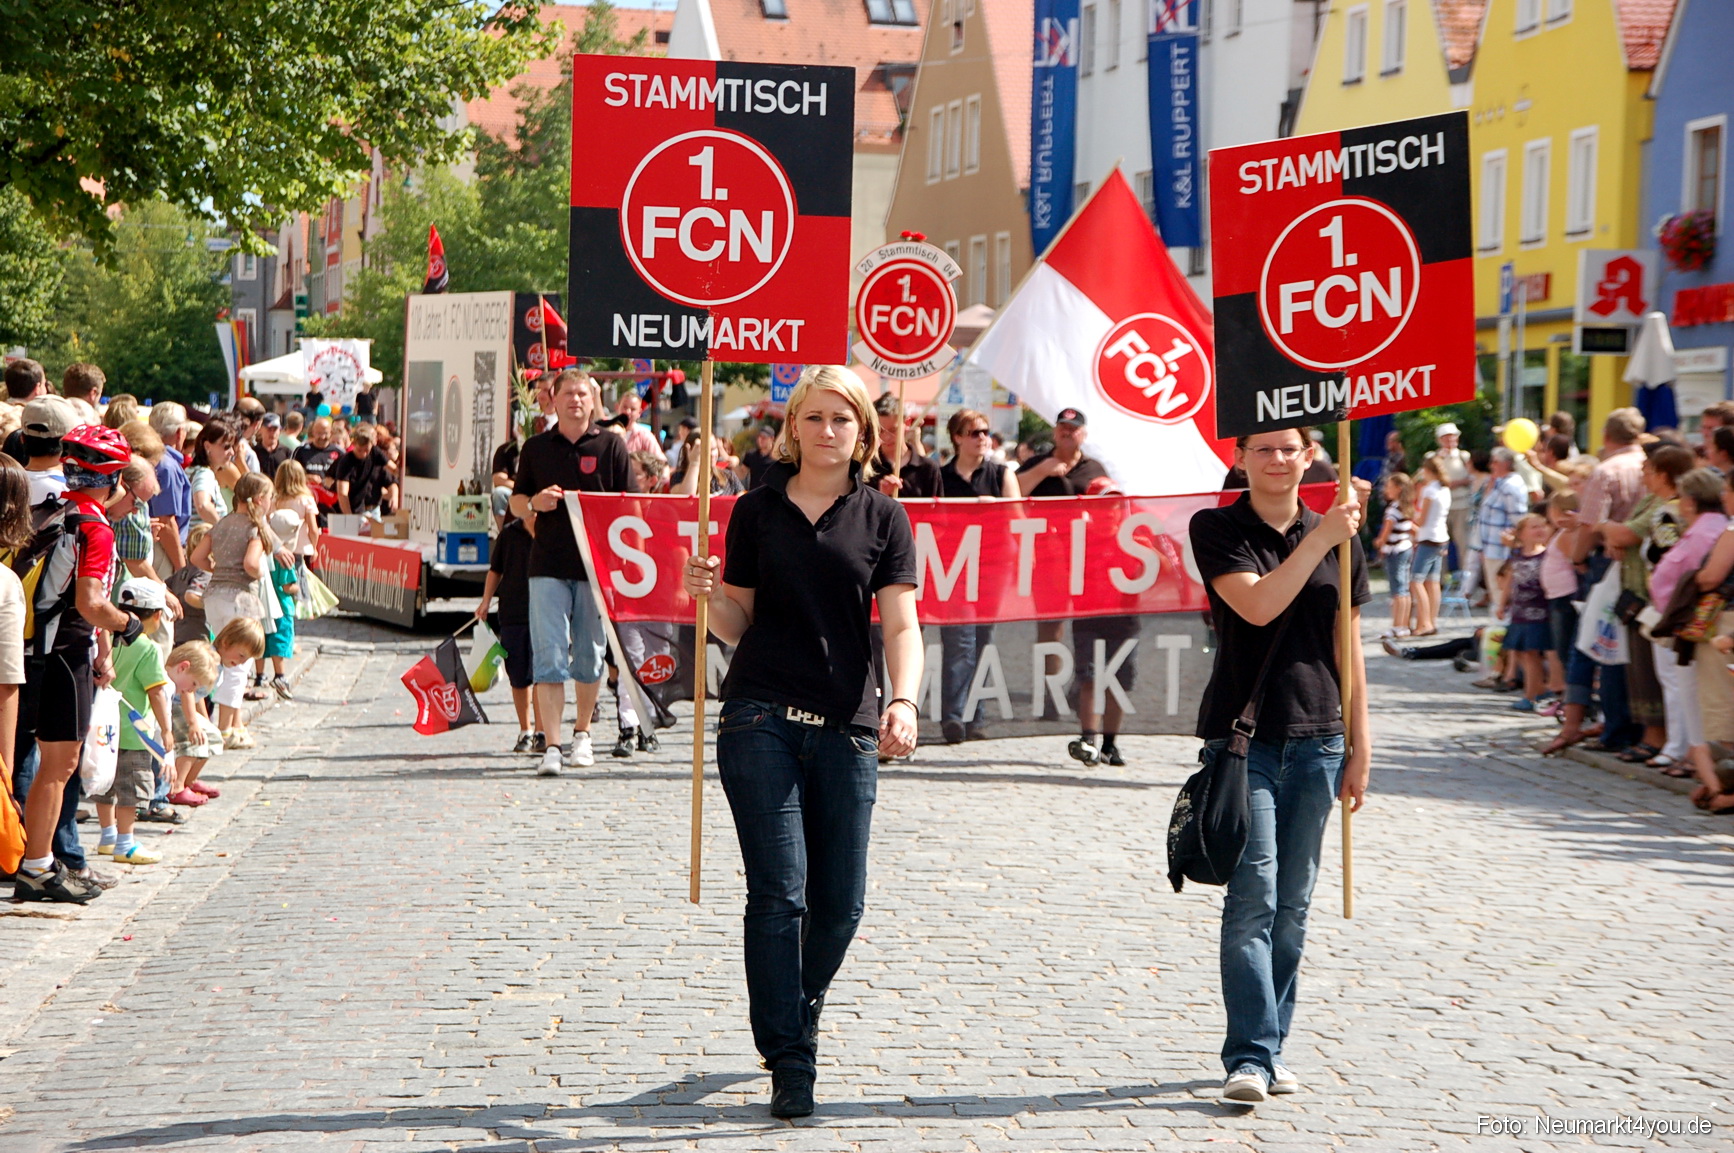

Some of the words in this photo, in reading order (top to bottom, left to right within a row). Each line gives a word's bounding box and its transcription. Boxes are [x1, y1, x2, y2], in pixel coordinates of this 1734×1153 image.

[604, 72, 828, 117] STAMMTISCH
[1170, 43, 1191, 158] RUPPERT
[688, 145, 729, 201] 1.
[1238, 131, 1446, 195] STAMMTISCH
[1174, 169, 1192, 208] K&L
[641, 205, 774, 263] FCN
[1318, 215, 1359, 268] 1.
[860, 259, 874, 274] 20
[878, 245, 939, 264] Stammtisch
[943, 264, 956, 278] 04
[896, 273, 917, 303] 1.
[1278, 266, 1403, 335] FCN
[451, 302, 462, 340] FC
[463, 296, 508, 340] NÜRNBERG
[612, 313, 806, 352] NEUMARKT
[869, 304, 940, 338] FCN
[870, 356, 936, 378] Neumarkt
[1103, 329, 1190, 417] FCN
[1161, 337, 1194, 373] 1.
[1256, 364, 1437, 423] NEUMARKT
[319, 543, 364, 603] Stammtisch
[363, 551, 409, 614] Neumarkt
[640, 663, 673, 682] FCN
[650, 658, 662, 670] 1.
